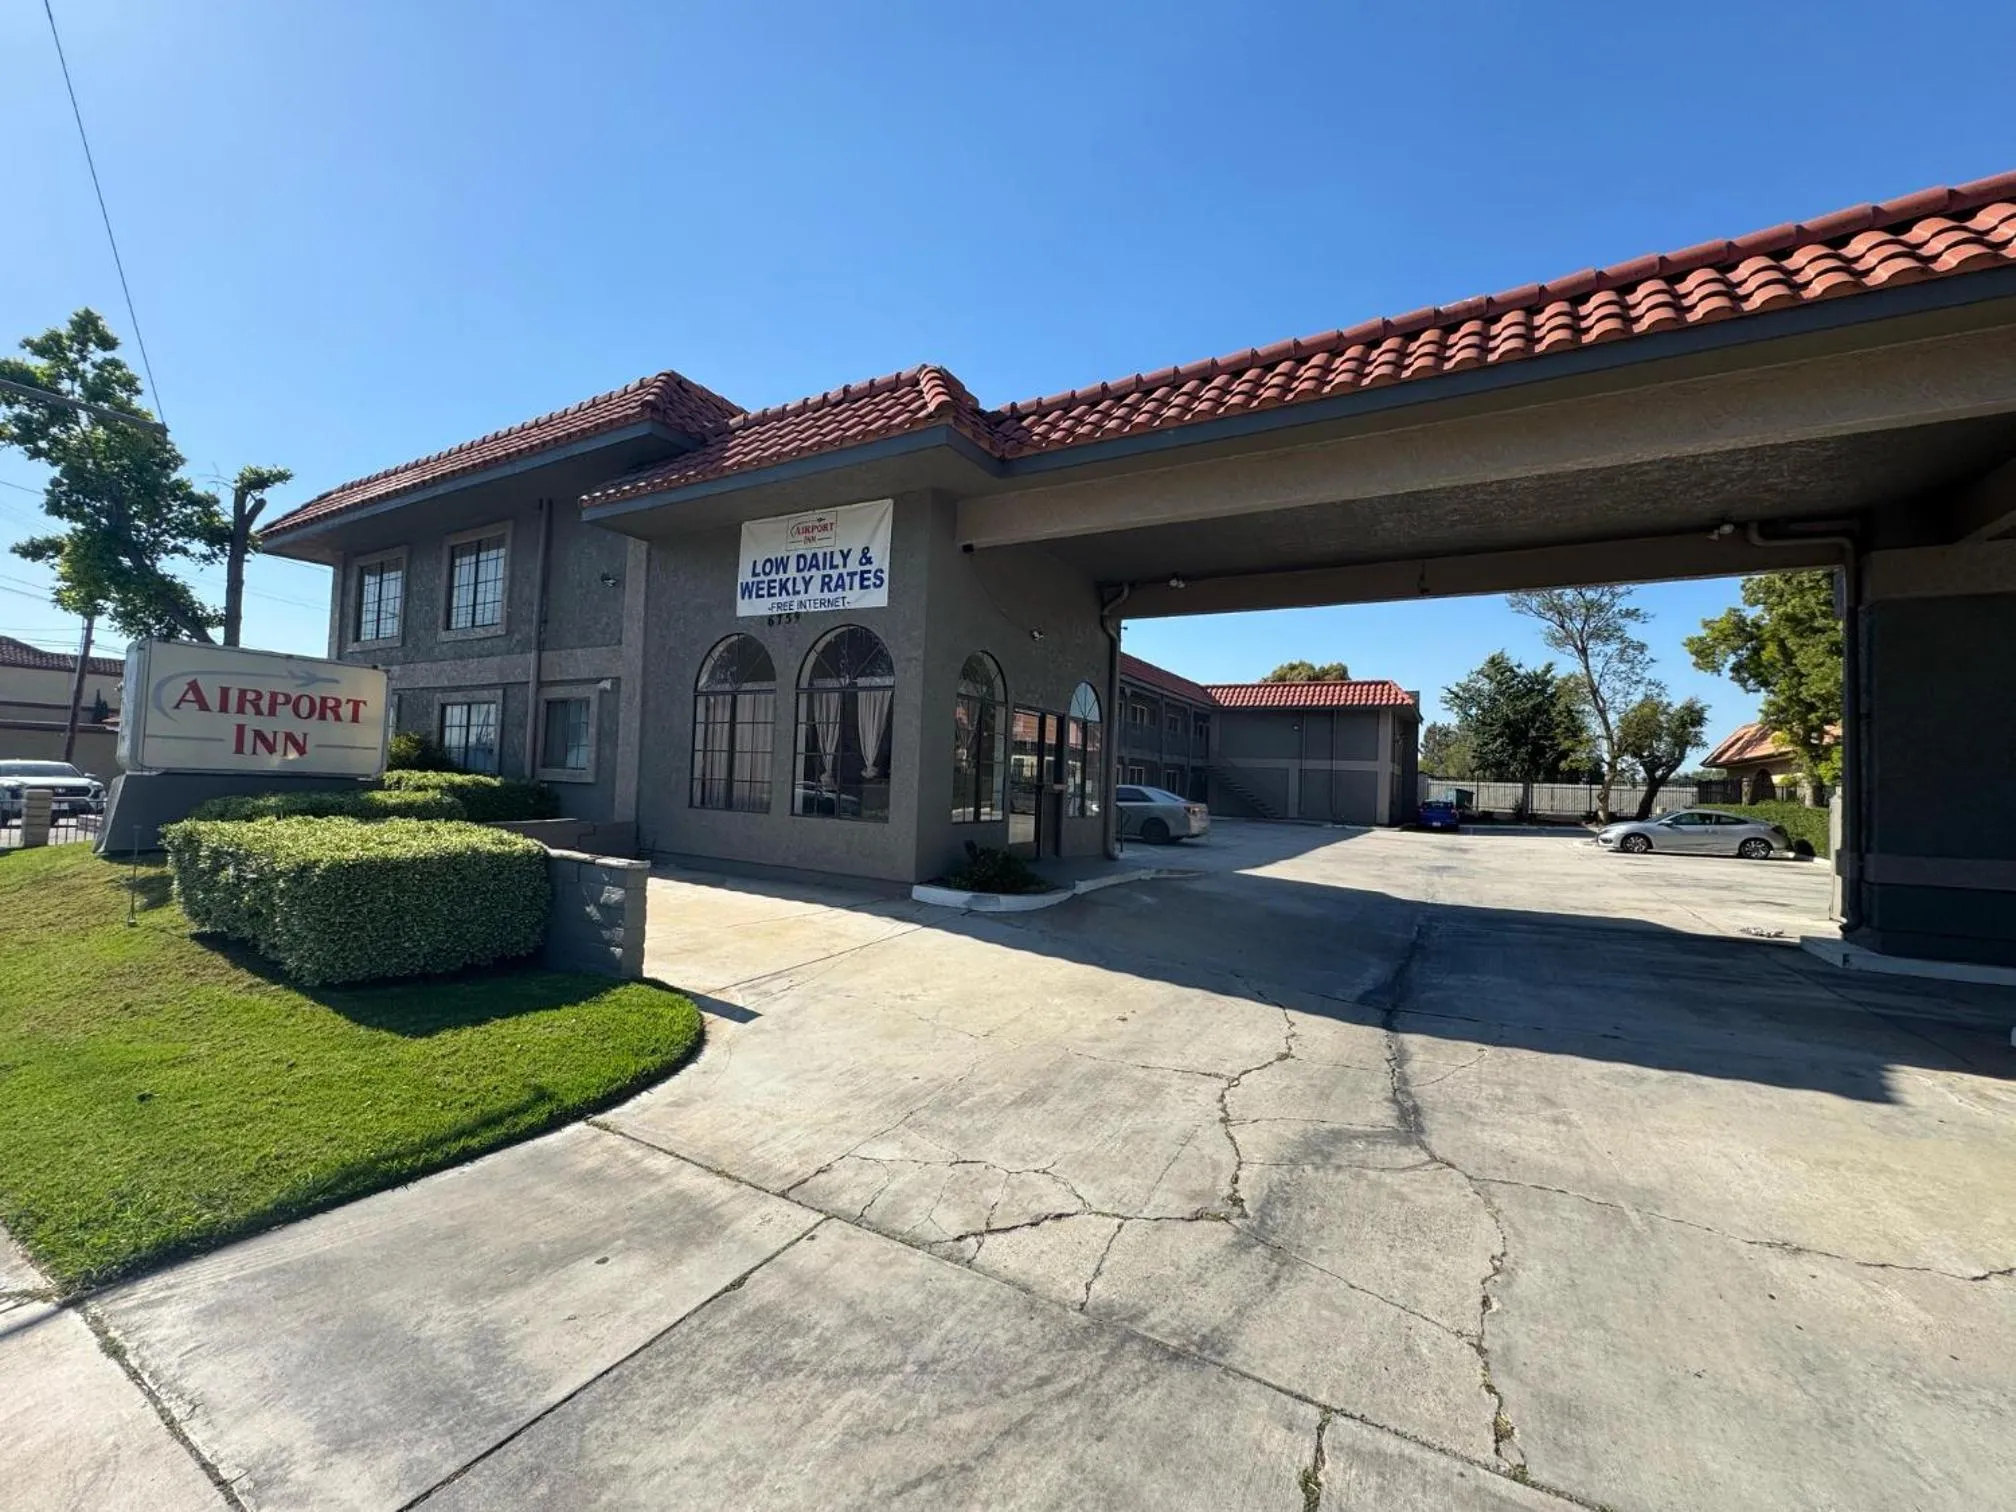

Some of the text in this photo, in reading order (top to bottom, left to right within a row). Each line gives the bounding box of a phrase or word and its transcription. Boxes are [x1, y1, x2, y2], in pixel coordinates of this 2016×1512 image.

[751, 546, 874, 578] LOW DAILY &
[740, 568, 884, 600] WEEKLY RATES
[173, 678, 367, 723] AIRPORT
[232, 723, 310, 758] INN
